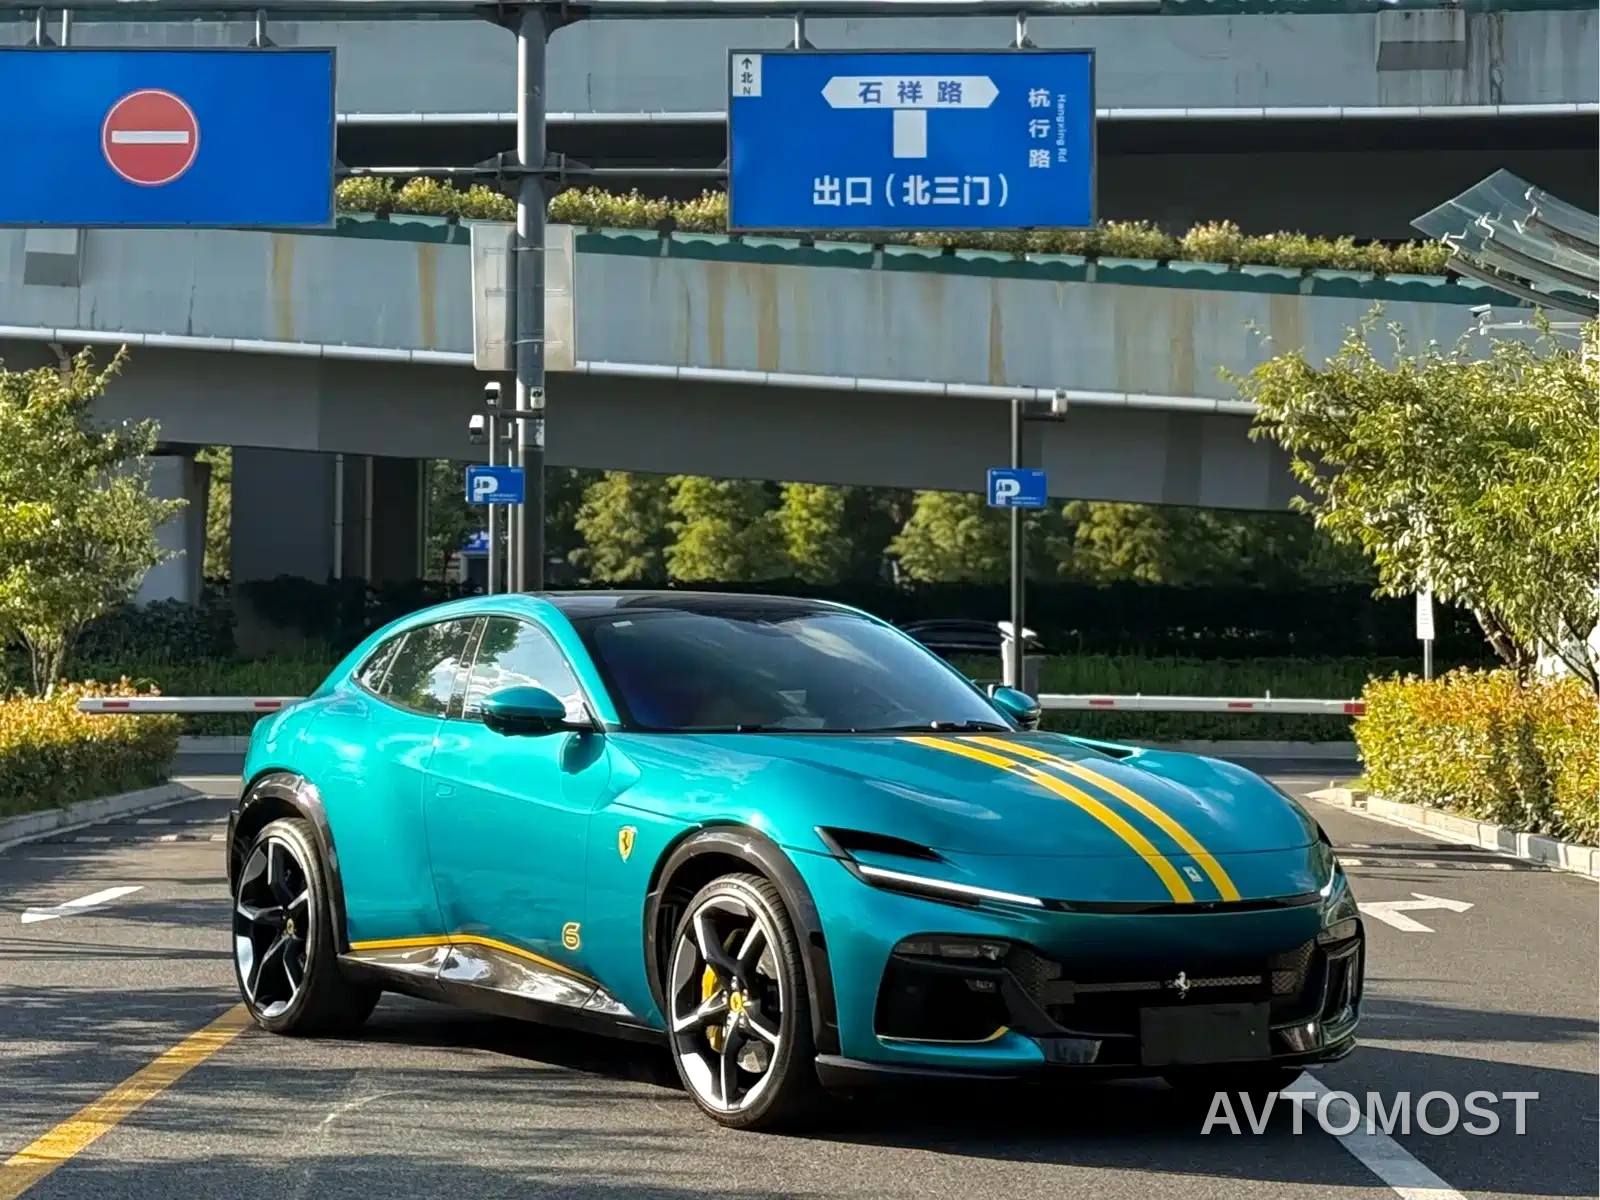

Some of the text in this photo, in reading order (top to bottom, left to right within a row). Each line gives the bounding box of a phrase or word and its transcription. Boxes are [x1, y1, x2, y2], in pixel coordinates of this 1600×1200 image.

[740, 72, 754, 84] 北
[743, 87, 751, 95] N
[858, 81, 963, 104] 石祥路
[1028, 88, 1051, 169] 杭行路
[1056, 94, 1068, 163] Hangxing Rd
[562, 921, 581, 950] 6
